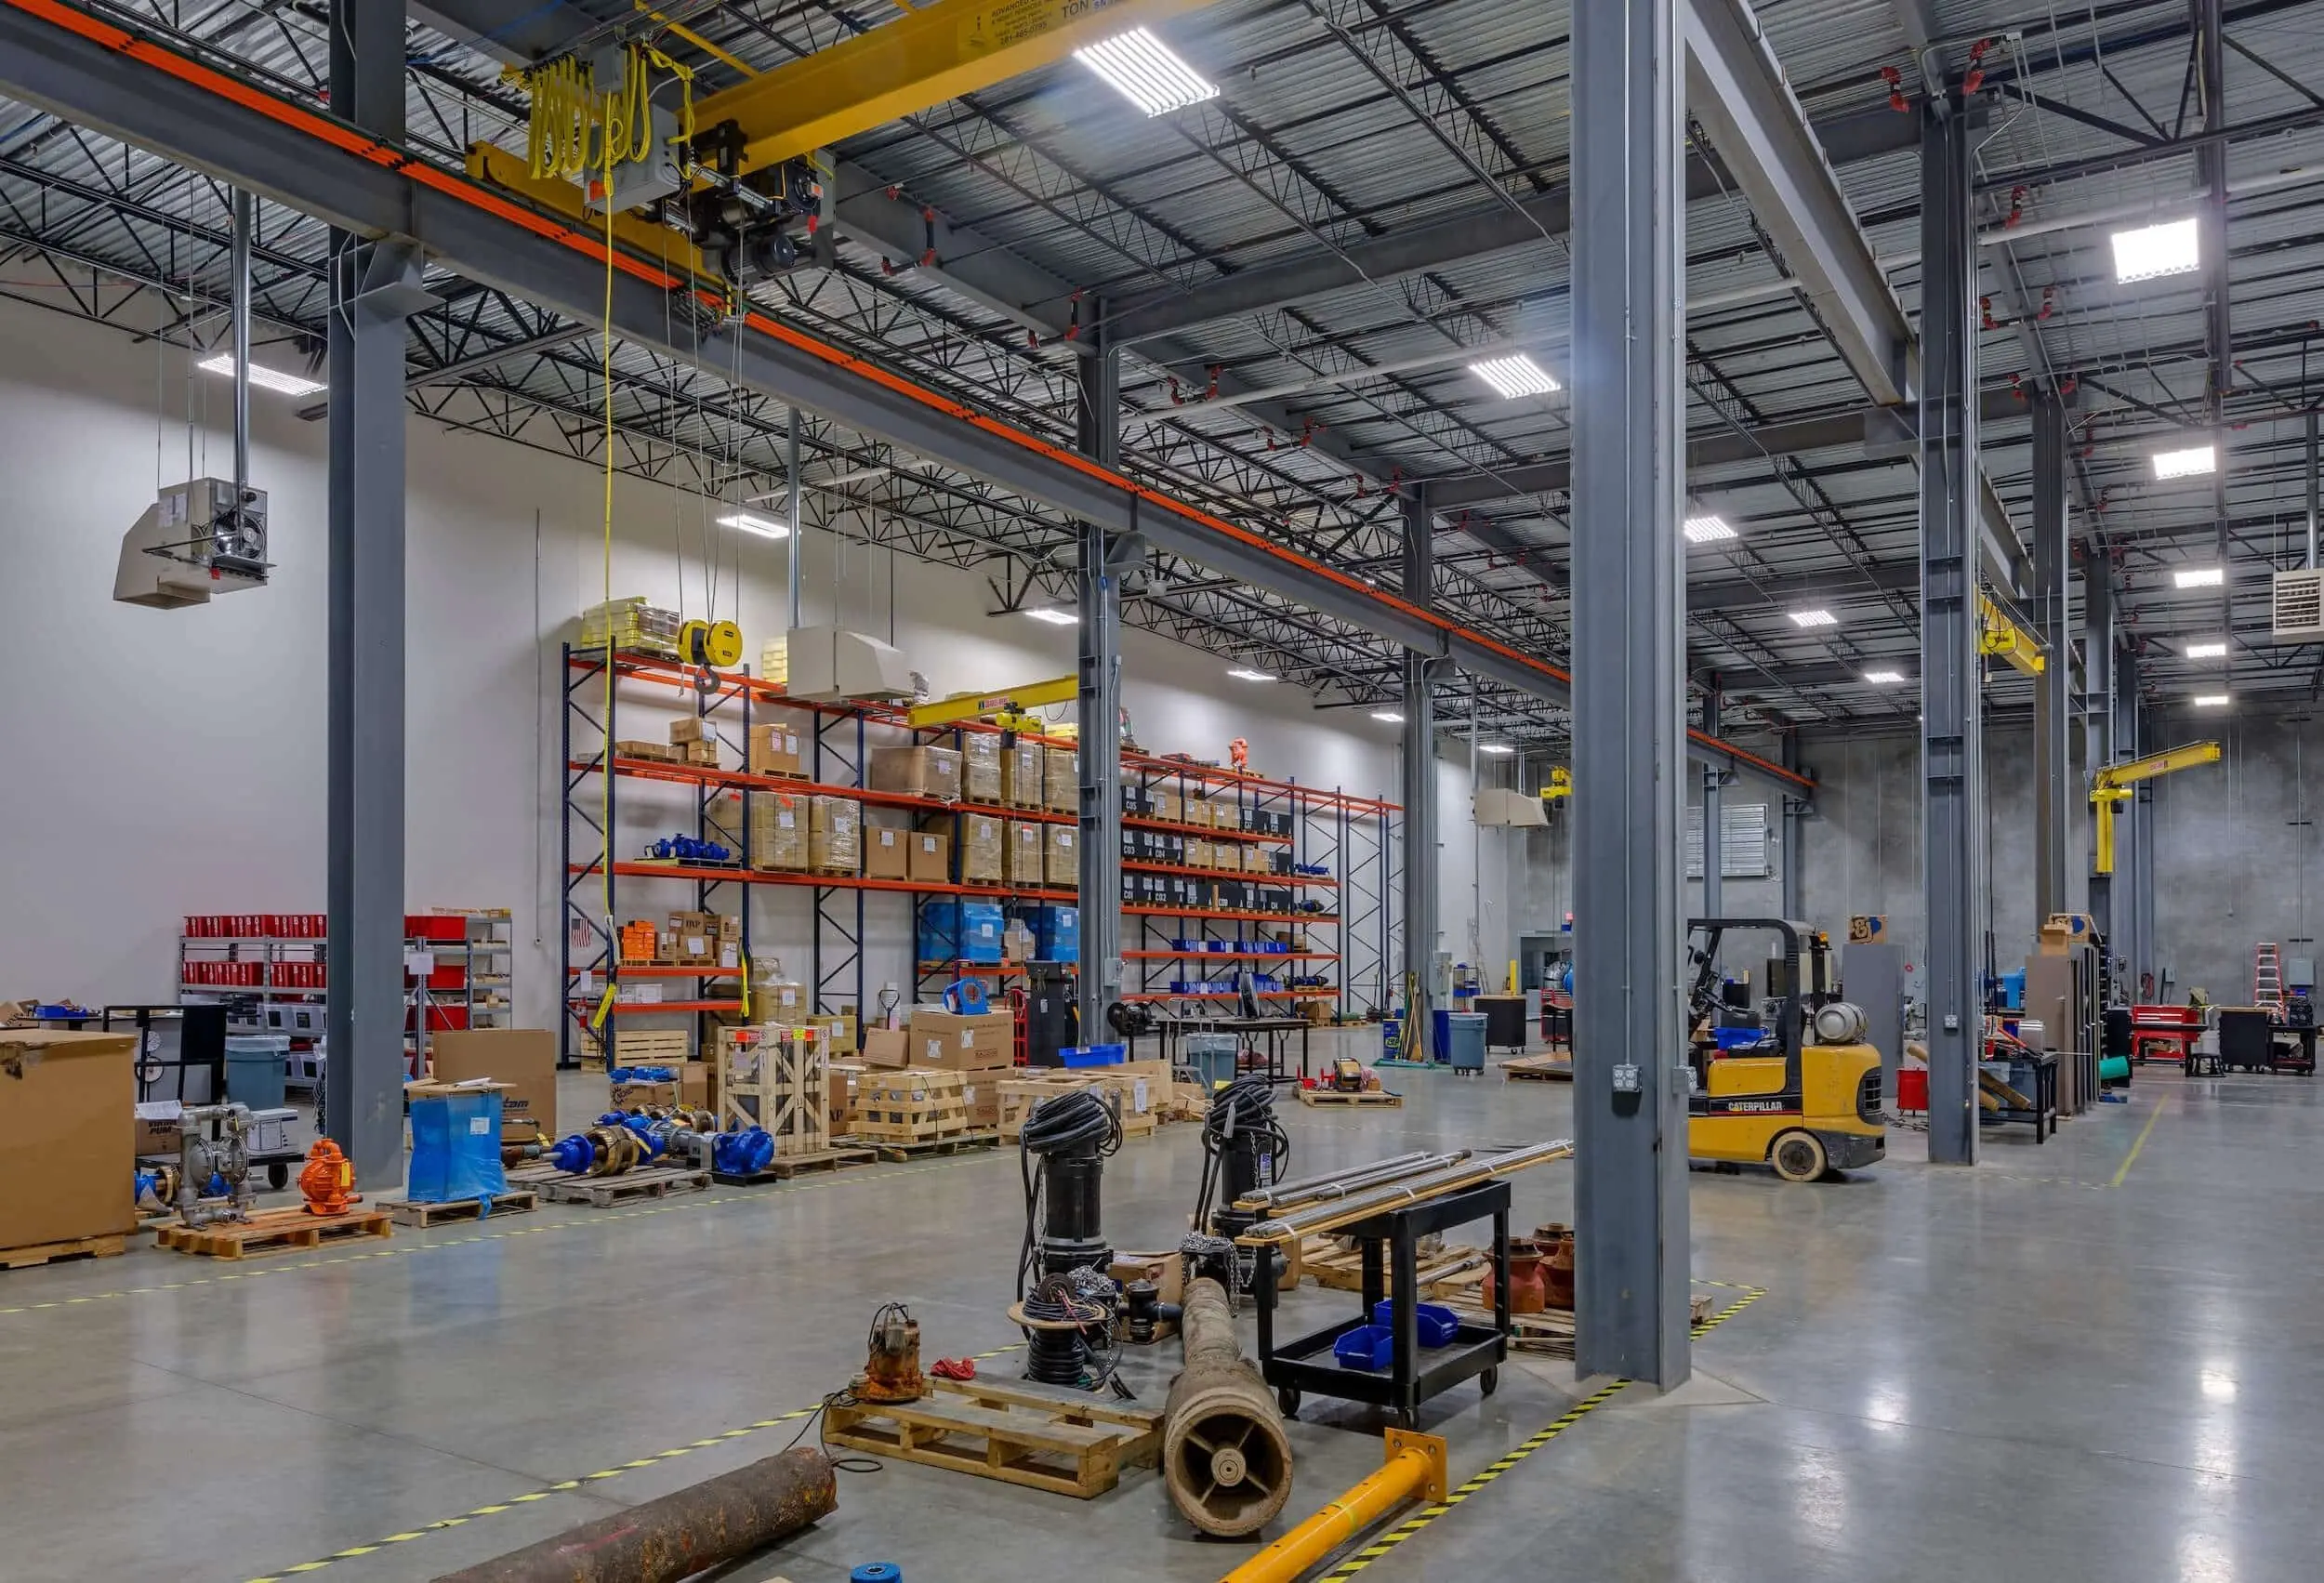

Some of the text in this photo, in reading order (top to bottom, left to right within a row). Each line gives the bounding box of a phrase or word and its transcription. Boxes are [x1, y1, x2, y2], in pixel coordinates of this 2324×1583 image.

[1062, 0, 1089, 18] TON
[1728, 1101, 1783, 1112] CATERPILLAR
[150, 1126, 172, 1134] PUM
